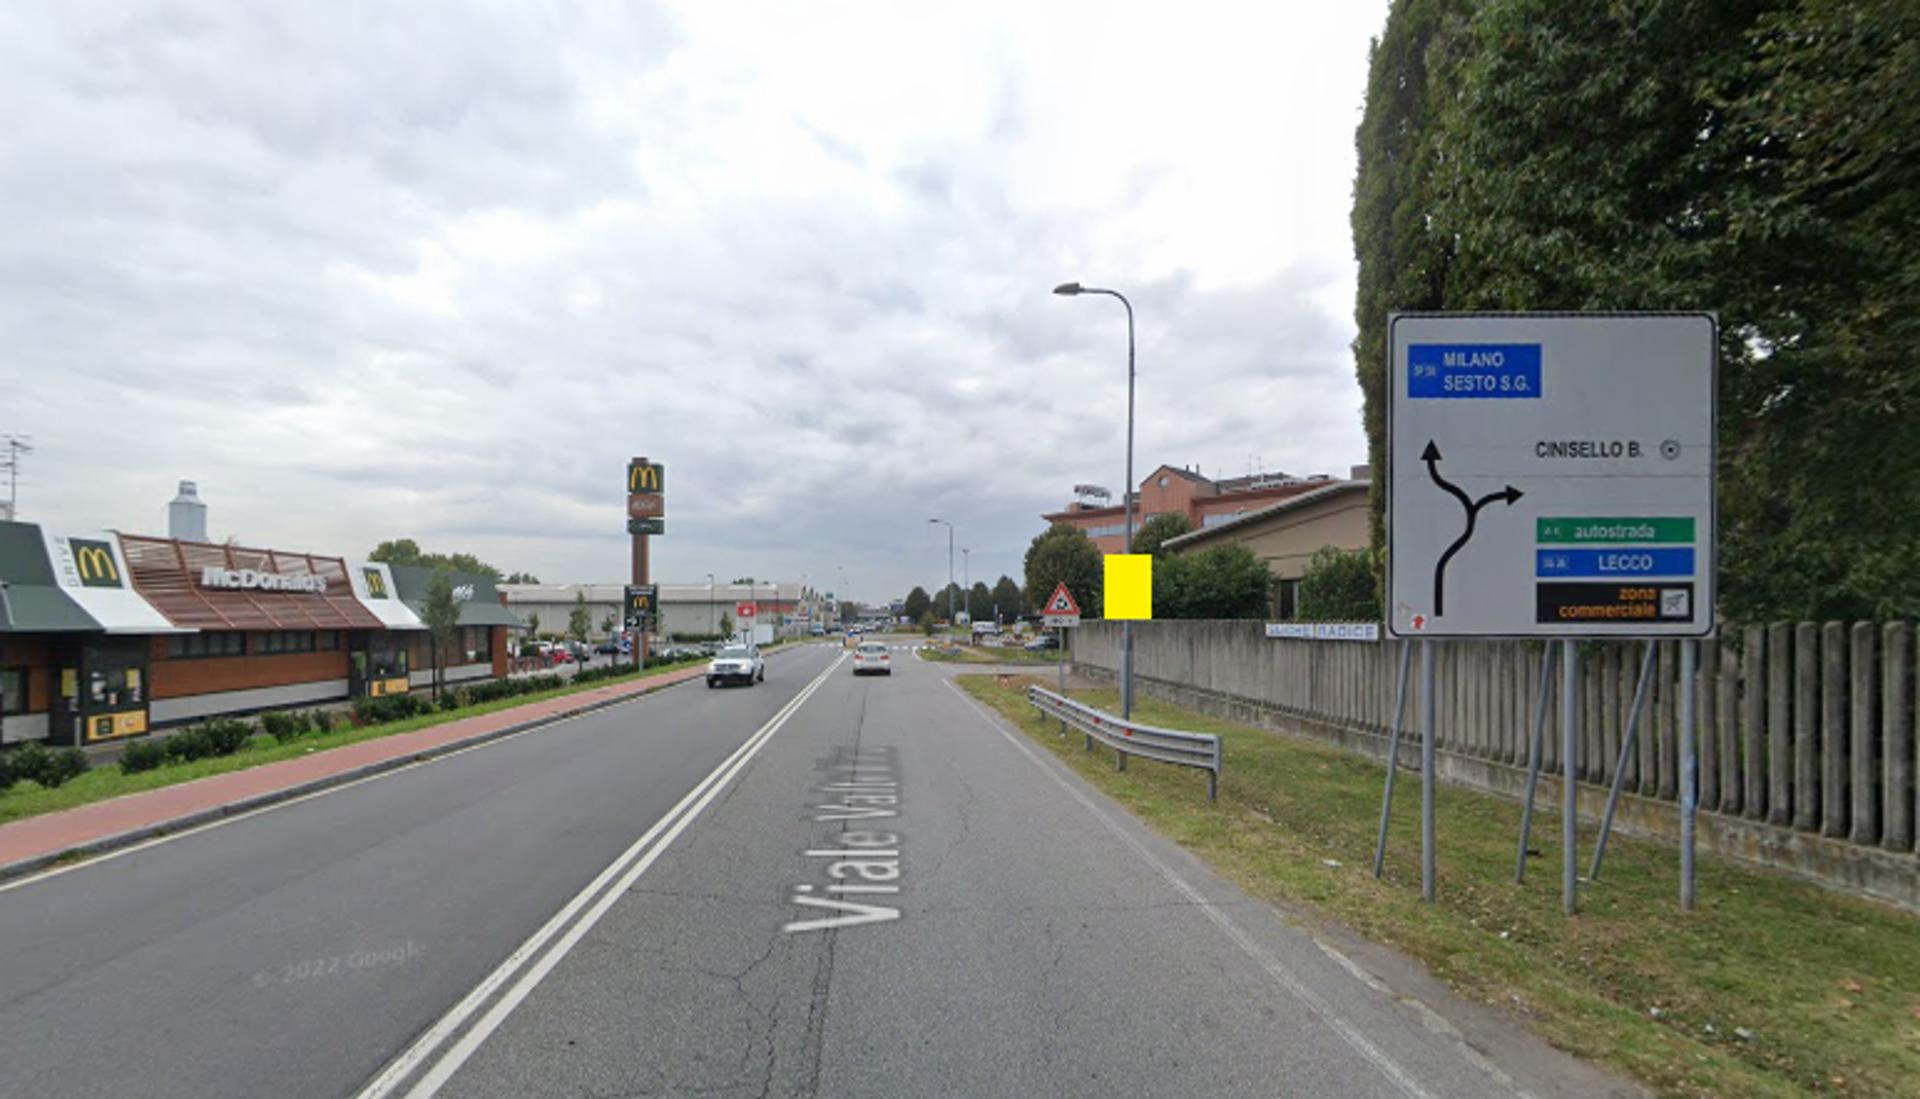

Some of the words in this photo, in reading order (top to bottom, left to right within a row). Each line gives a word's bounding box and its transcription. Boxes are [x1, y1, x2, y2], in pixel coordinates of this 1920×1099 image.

[1443, 351, 1505, 367] MILANO
[1443, 375, 1497, 391] SESTO
[1499, 375, 1531, 391] S.G.
[1535, 441, 1622, 459] CINISELLO
[1627, 442, 1644, 458] B.
[1573, 523, 1656, 539] autostrada
[1598, 554, 1653, 571] LECCO
[1618, 587, 1657, 600] zona
[1558, 601, 1657, 618] commerciale
